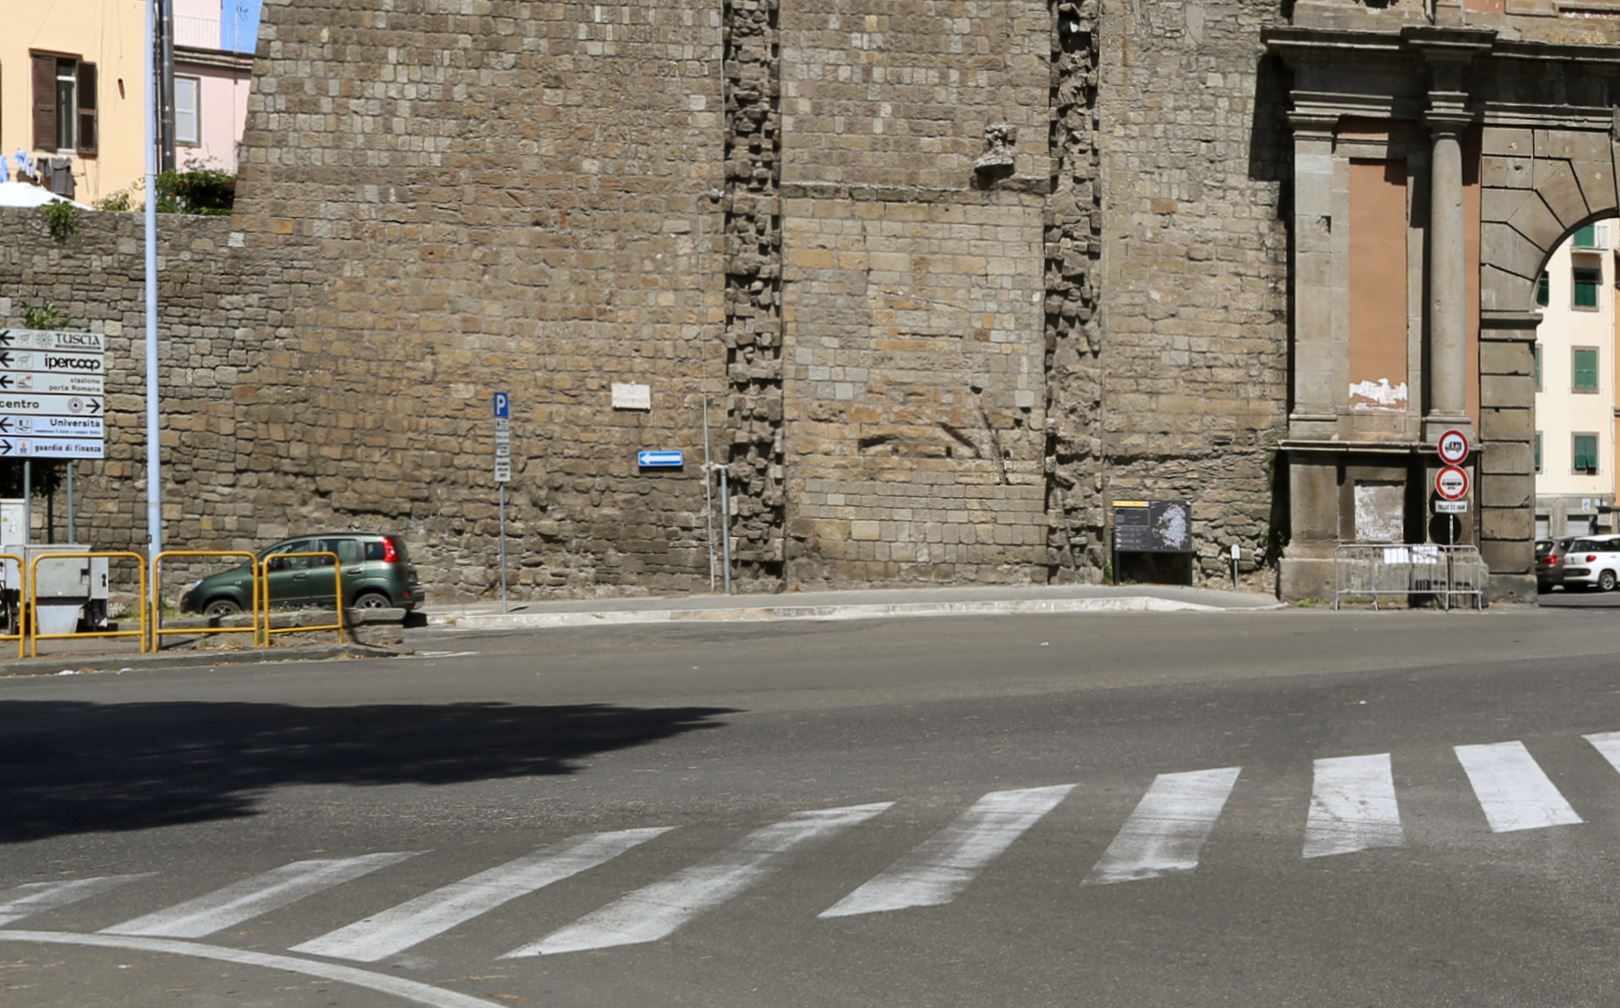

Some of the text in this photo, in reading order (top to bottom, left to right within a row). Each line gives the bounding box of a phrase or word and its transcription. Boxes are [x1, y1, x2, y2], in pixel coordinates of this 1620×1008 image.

[55, 333, 101, 346] TUSCIA
[44, 353, 101, 371] ipercoop
[71, 385, 101, 393] Romana
[0, 399, 40, 409] centro
[34, 443, 101, 453] guardia di finanza
